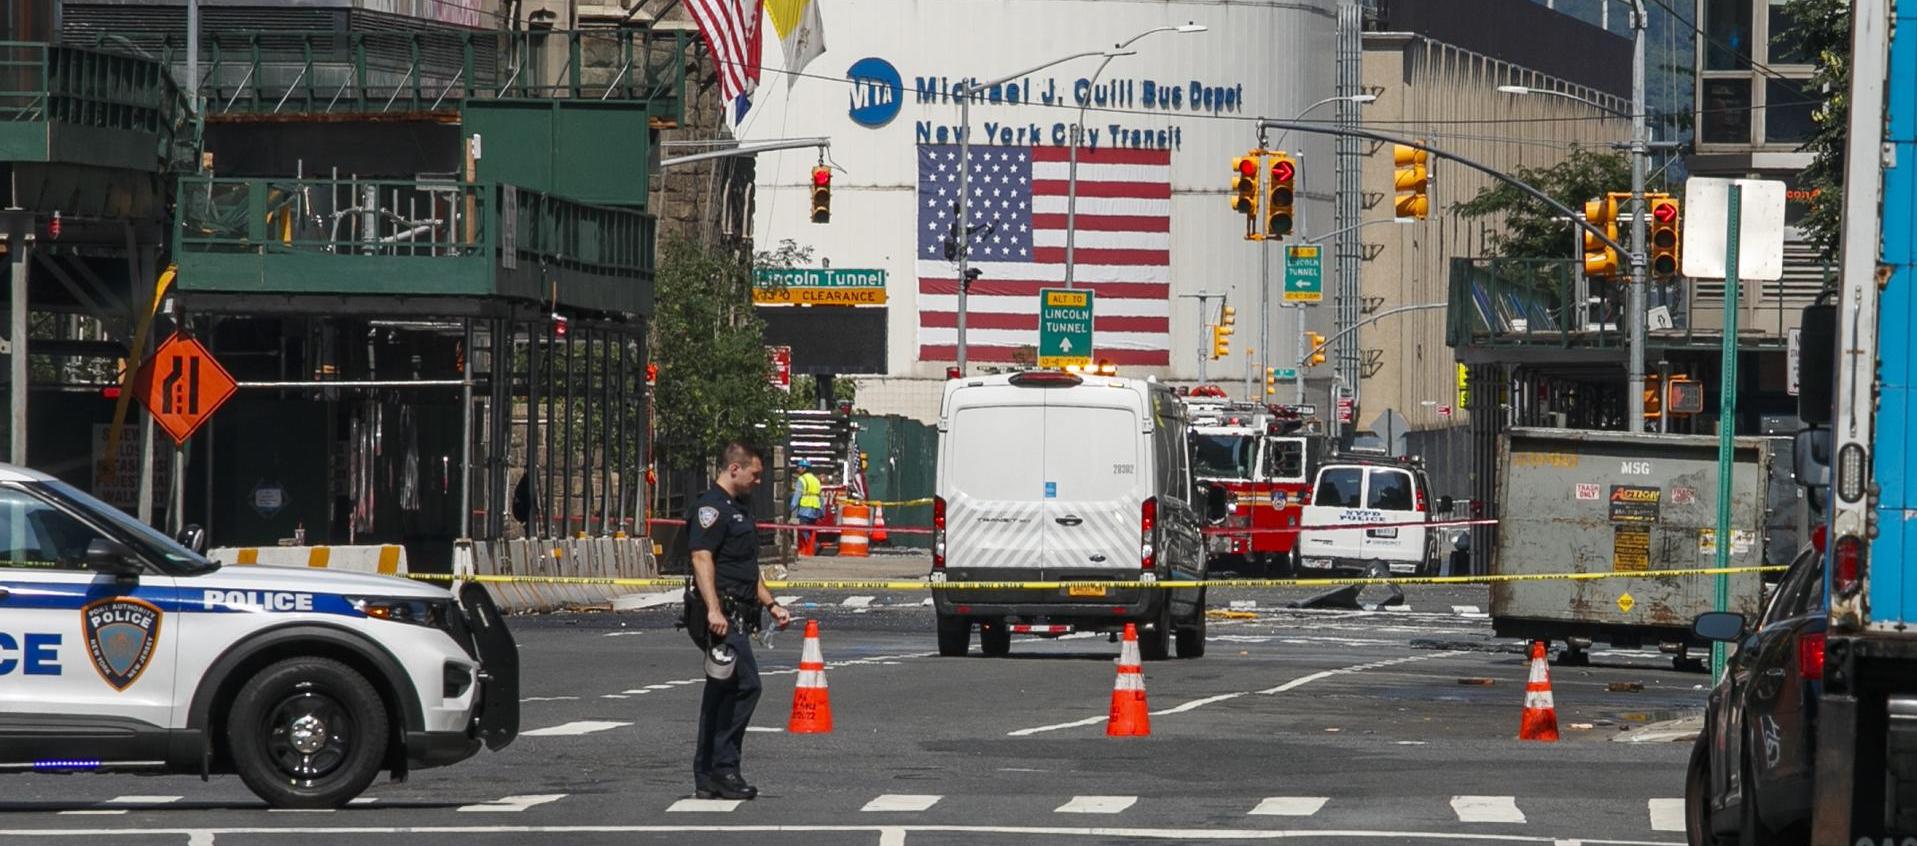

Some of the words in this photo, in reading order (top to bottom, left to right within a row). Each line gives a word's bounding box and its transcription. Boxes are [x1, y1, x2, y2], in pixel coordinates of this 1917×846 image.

[848, 77, 893, 110] MTA
[915, 76, 1029, 105] Michael
[1041, 78, 1064, 107] J.
[1074, 78, 1133, 109] Quill
[1142, 80, 1182, 110] Bus
[1190, 80, 1242, 117] Depot
[915, 120, 970, 144] New
[984, 121, 1041, 145] York
[1052, 122, 1099, 154] City
[1108, 124, 1182, 151] Transit
[756, 270, 819, 286] Lincoln
[824, 270, 882, 286] Tunnel
[802, 290, 876, 302] CLEARANCE
[1053, 295, 1067, 303] ALT
[1072, 295, 1082, 304] TO
[1045, 309, 1089, 320] LINCOLN
[1046, 322, 1088, 333] TUNNEL
[1621, 461, 1650, 475] MSG
[203, 589, 313, 611] POLICE
[112, 603, 156, 619] AUTHORITY
[90, 610, 153, 629] POLICE
